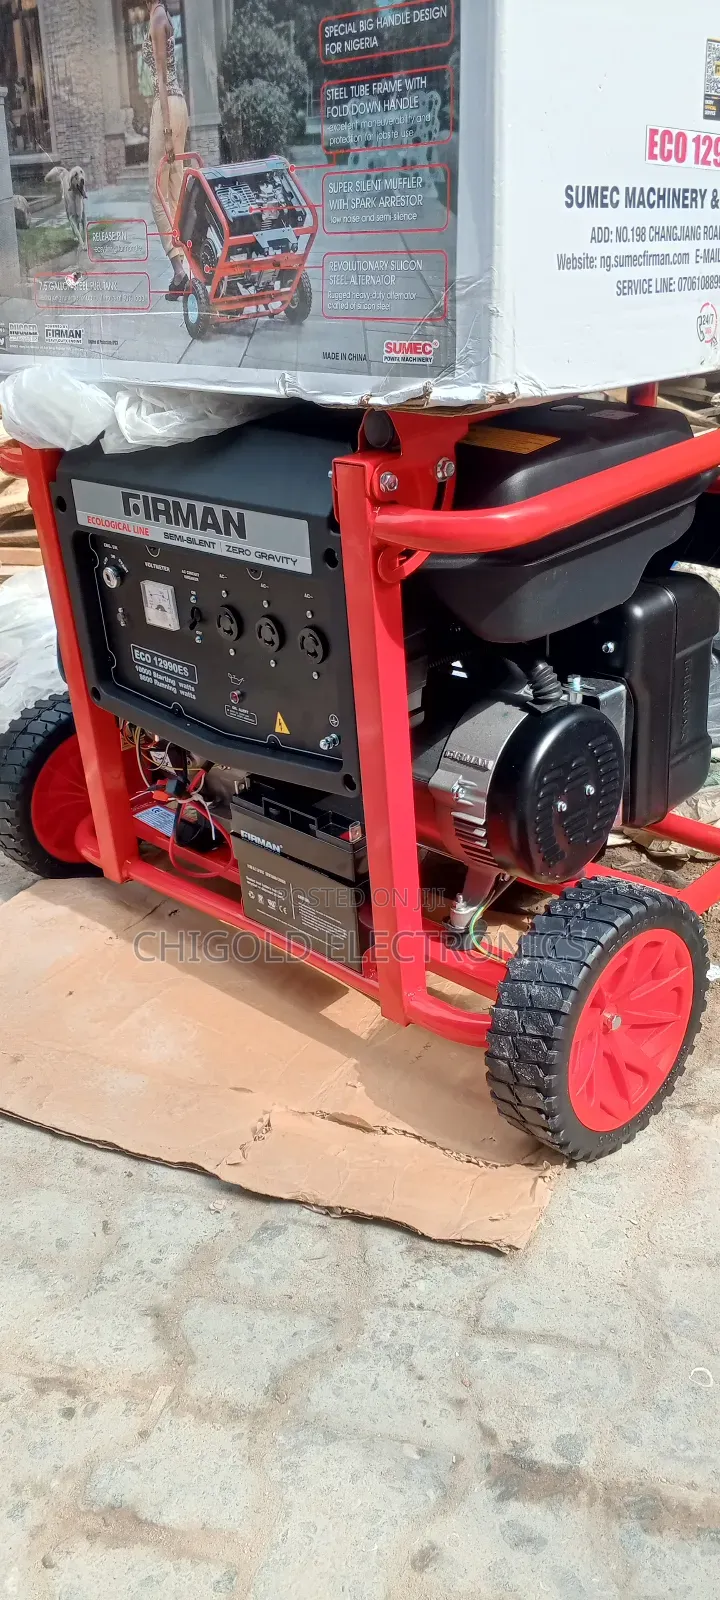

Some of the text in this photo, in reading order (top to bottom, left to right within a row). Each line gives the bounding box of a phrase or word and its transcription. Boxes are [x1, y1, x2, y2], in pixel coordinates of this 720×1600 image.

[324, 5, 447, 38] SPECIAL BIG HANDLE DESIGN
[326, 36, 378, 56] FOR NIGERIA
[326, 76, 427, 101] STEEL TUBE FRAME WITH
[326, 96, 419, 118] FOLD DOWN HANDLE
[417, 112, 431, 122] and
[402, 129, 414, 138] use
[648, 128, 688, 164] ECO
[328, 176, 422, 194] SUPER SILENT MUFFLER
[328, 194, 423, 210] WITH SPARK ARRESTOR
[564, 184, 720, 209] SUMEC MACHINERY &
[362, 213, 374, 222] and
[590, 226, 613, 244] ADD:
[615, 226, 646, 243] NO.198
[649, 226, 702, 242] CHANGJIANG
[329, 260, 422, 272] REVOLUTIONARY SILICON
[557, 252, 598, 270] Website:
[600, 250, 690, 272] ng.sumecfirman.com
[330, 274, 396, 286] STEEL ALTERNATOR
[616, 278, 653, 296] SERVICE
[655, 277, 676, 294] LINE:
[377, 302, 390, 311] steel
[702, 314, 714, 325] 24/7
[46, 328, 82, 338] FIRMAN
[322, 352, 367, 362] MADE IN CHINA
[384, 342, 432, 356] SUMEC
[120, 490, 248, 540] FIRMAN
[87, 515, 298, 566] ECOLOGICAL LINE SEMI-SILENT ZERO GRAVITY
[145, 562, 170, 572] VOLTMETER
[134, 649, 189, 677] ECO 12990ES
[134, 664, 196, 692] 10000 Starting watts
[154, 680, 178, 694] Running
[180, 690, 196, 700] watts
[240, 830, 281, 854] FIRMAN
